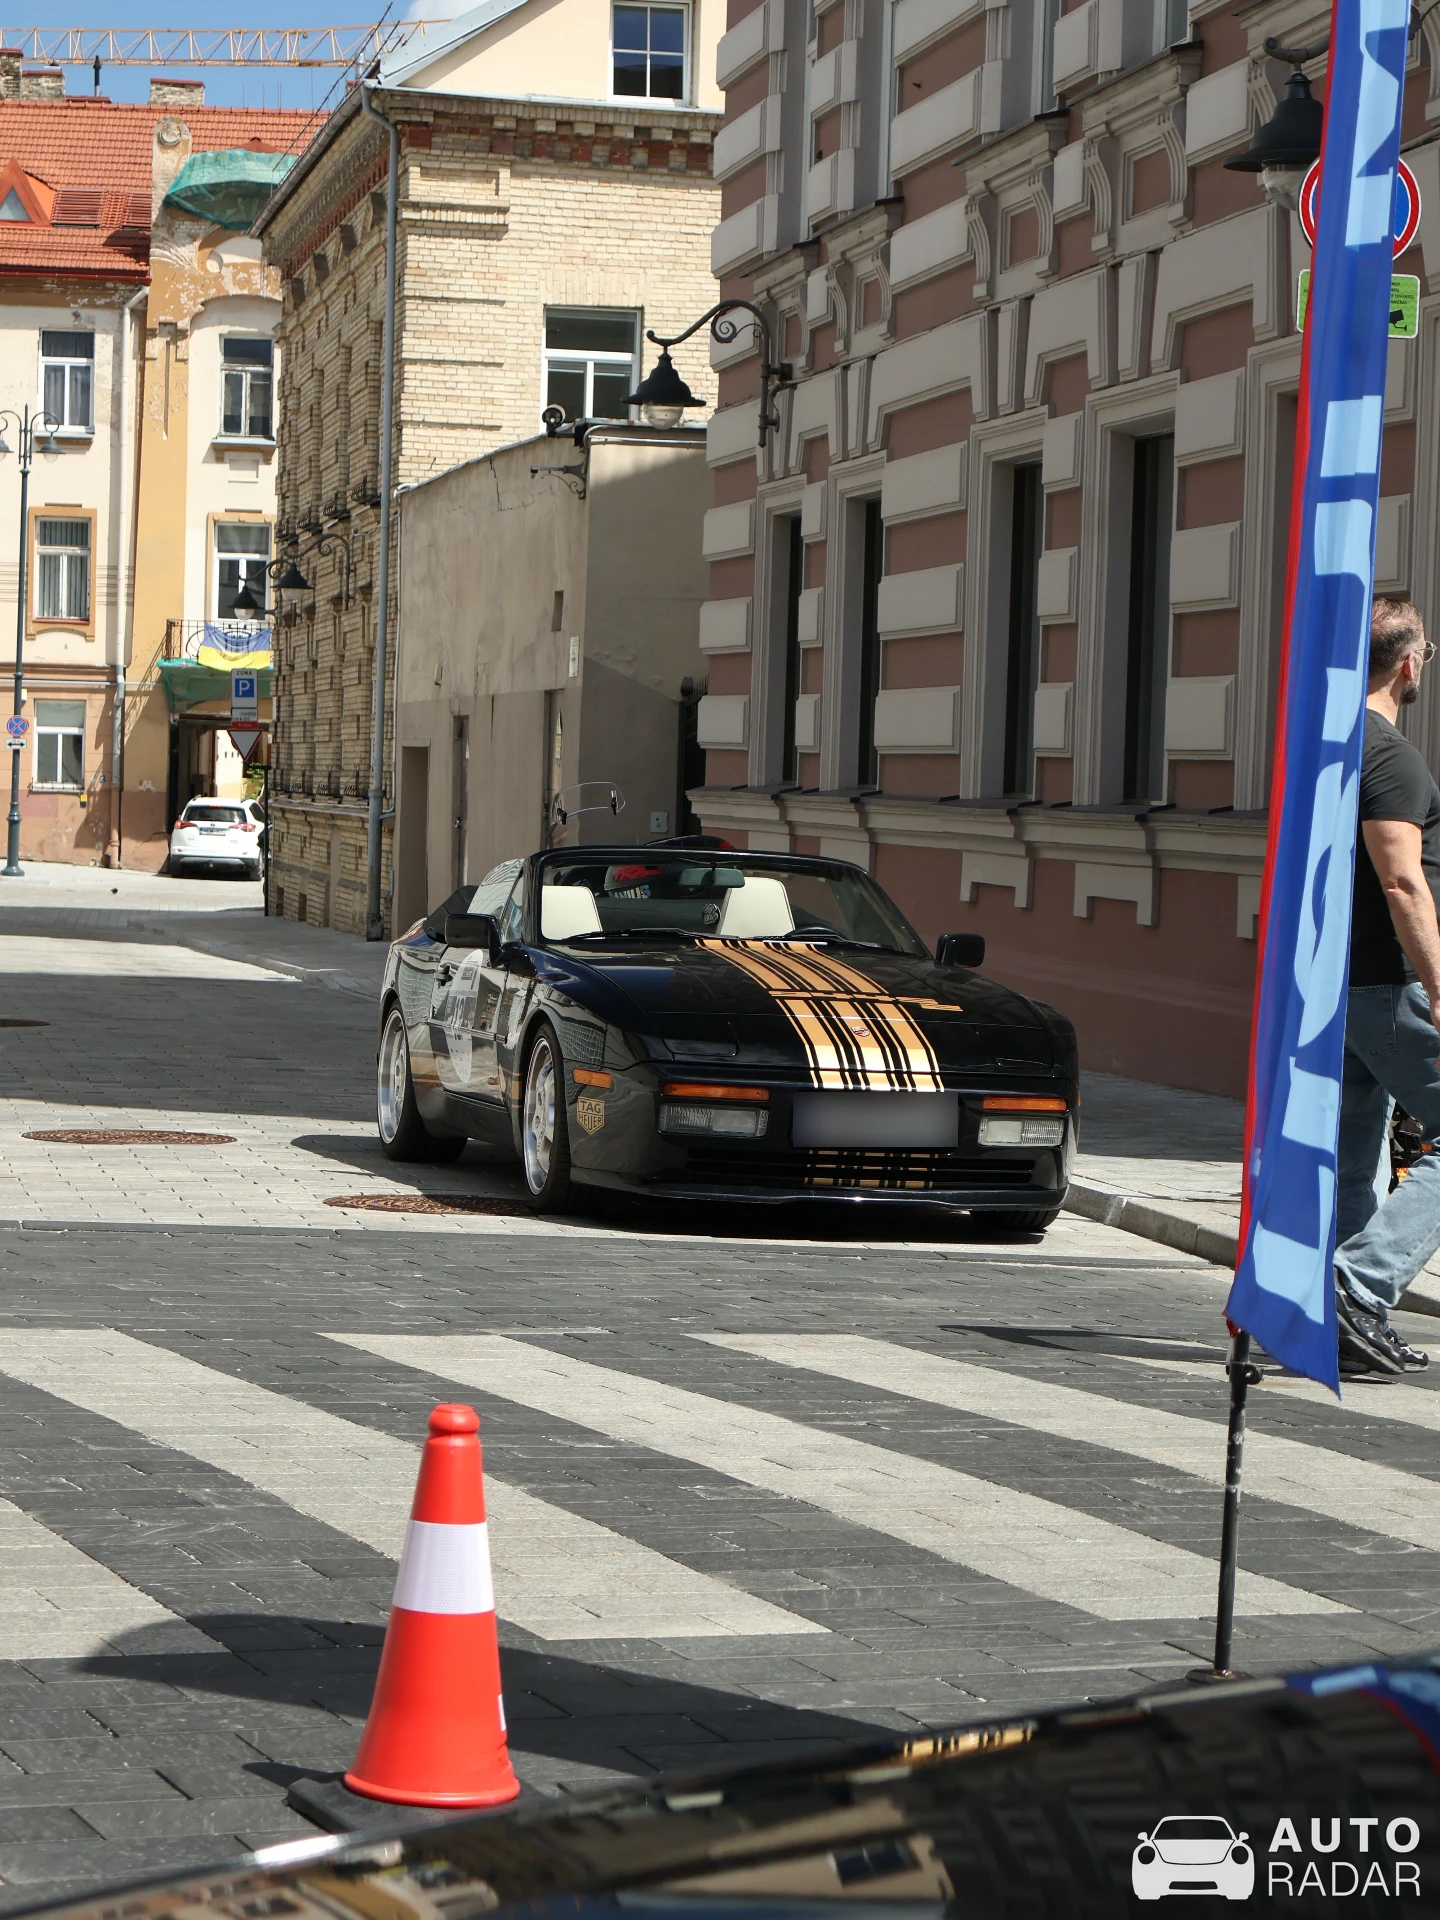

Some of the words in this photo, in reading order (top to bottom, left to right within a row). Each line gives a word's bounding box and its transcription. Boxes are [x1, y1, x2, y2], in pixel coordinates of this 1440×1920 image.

[239, 680, 251, 696] P
[580, 1100, 602, 1114] TAG
[578, 1113, 602, 1131] HEUER
